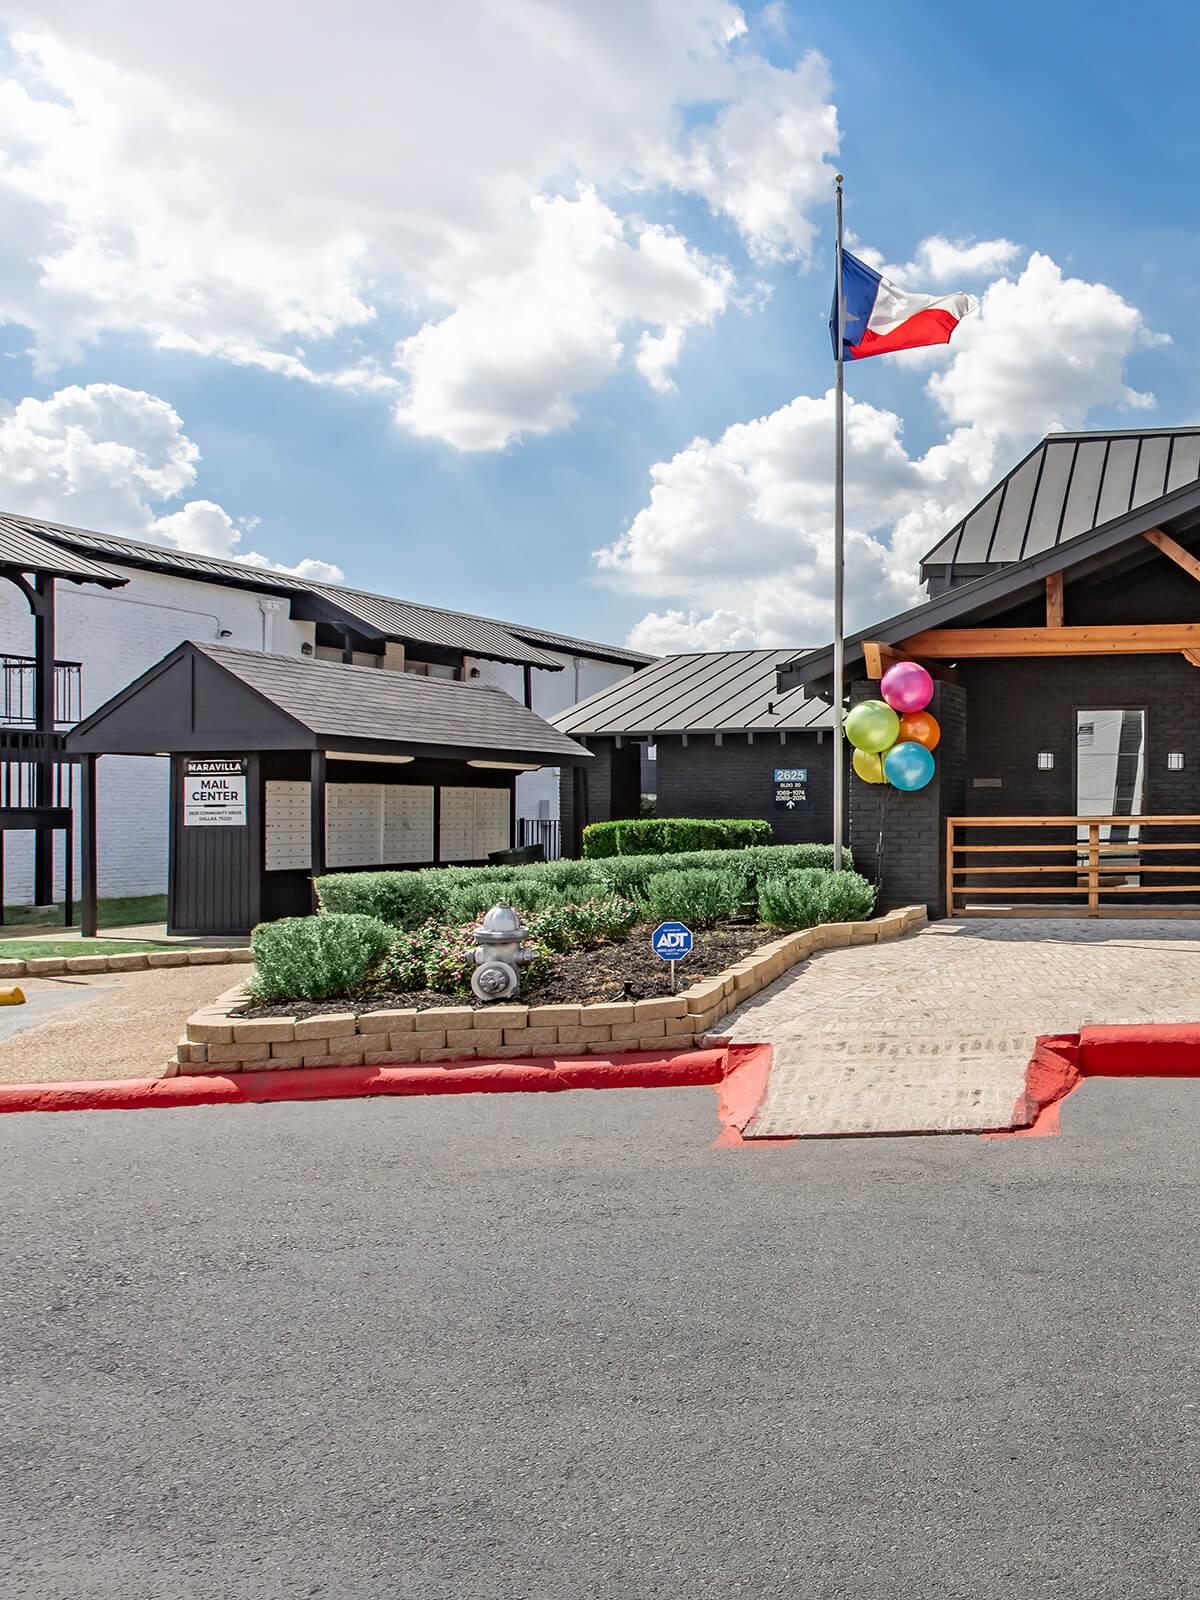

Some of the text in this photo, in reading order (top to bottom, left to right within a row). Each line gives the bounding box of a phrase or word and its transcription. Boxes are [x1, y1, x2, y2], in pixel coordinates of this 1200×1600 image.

[188, 763, 242, 771] MARAVILLA
[777, 770, 804, 780] 2625
[201, 780, 229, 789] MAIL
[192, 791, 239, 801] CENTER
[656, 932, 688, 948] ADT
